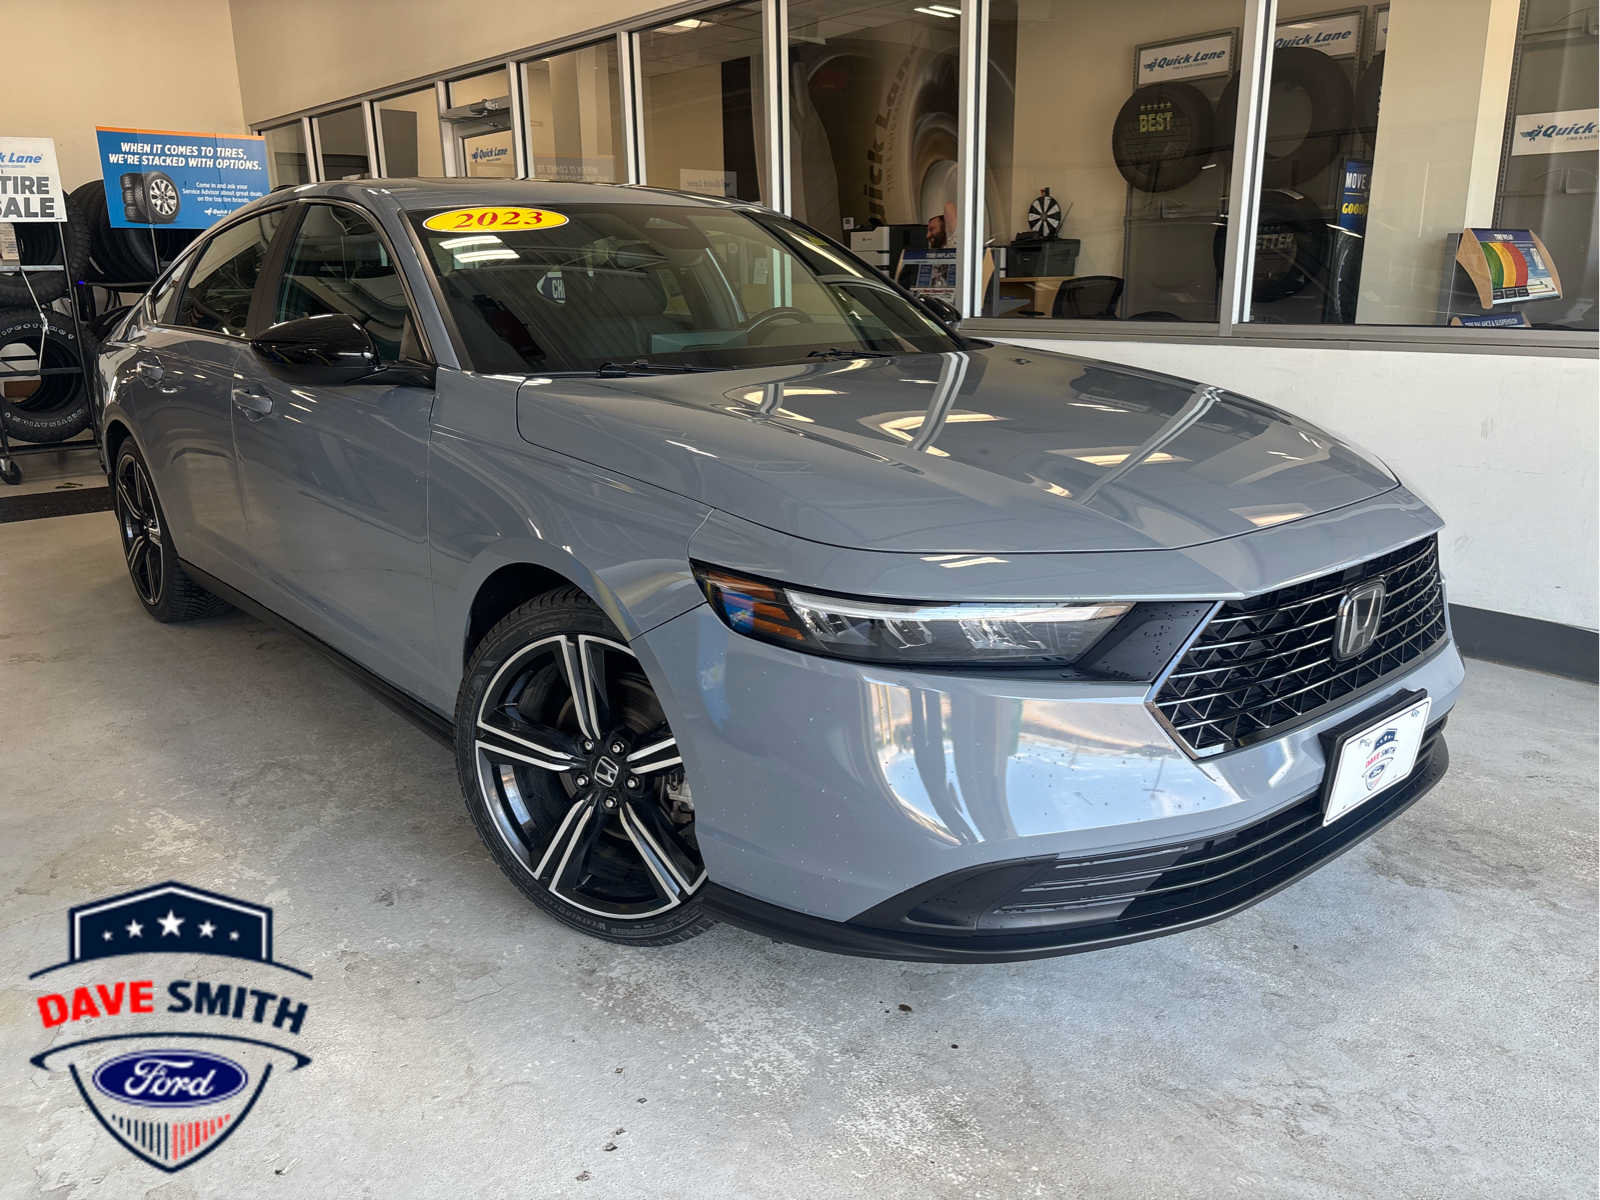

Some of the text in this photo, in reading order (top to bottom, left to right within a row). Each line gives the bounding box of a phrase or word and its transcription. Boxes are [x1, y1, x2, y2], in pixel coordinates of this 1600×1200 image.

[1314, 30, 1352, 43] Lane
[1157, 53, 1192, 68] Quick
[1192, 49, 1226, 62] Lane
[1139, 112, 1174, 132] BEST
[1543, 121, 1597, 138] Quick
[8, 152, 42, 164] Lane
[121, 142, 247, 160] WHEN IT COMES TO TIRES,
[109, 153, 262, 170] WE'RE STACKED WITH OPTIONS.
[0, 176, 49, 194] TIRE
[1345, 172, 1367, 189] MOVE
[0, 197, 54, 218] ALE
[454, 211, 543, 229] 2023
[1256, 233, 1296, 250] ETTER
